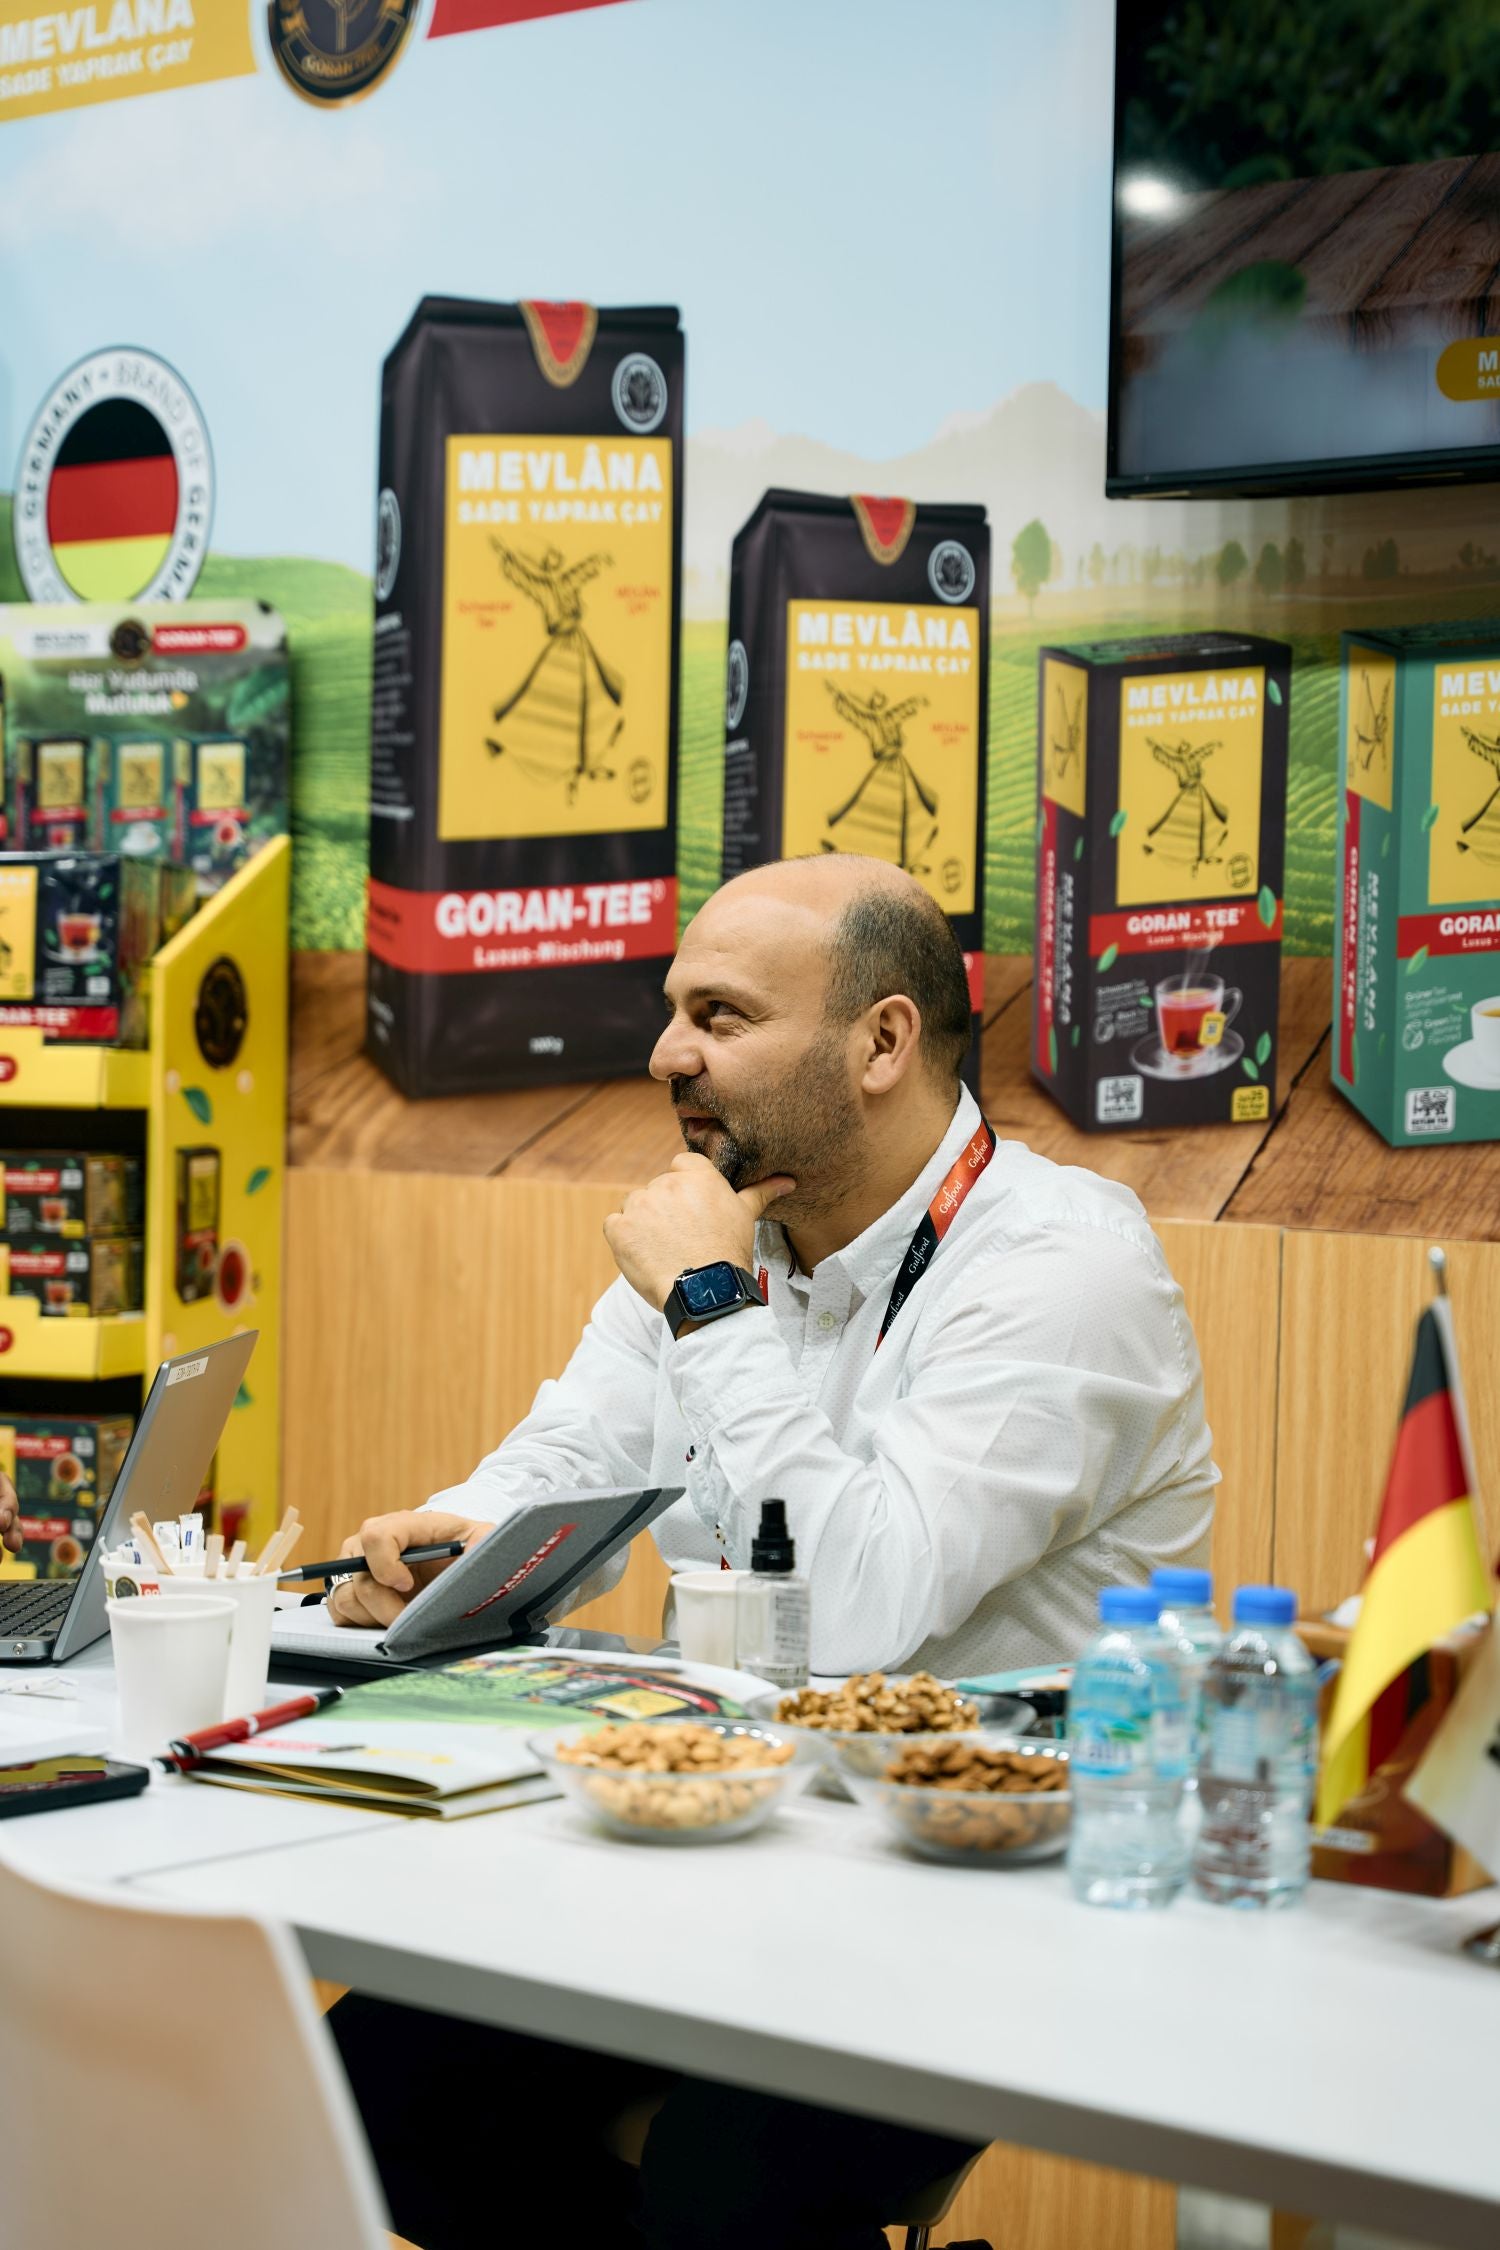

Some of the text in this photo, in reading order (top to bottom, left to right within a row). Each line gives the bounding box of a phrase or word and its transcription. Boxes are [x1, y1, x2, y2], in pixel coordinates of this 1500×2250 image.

[527, 501, 616, 523] YAPRAK
[968, 1139, 989, 1168] Gulfood
[938, 1179, 963, 1215] Gulfood
[908, 1236, 931, 1275] Gulfood
